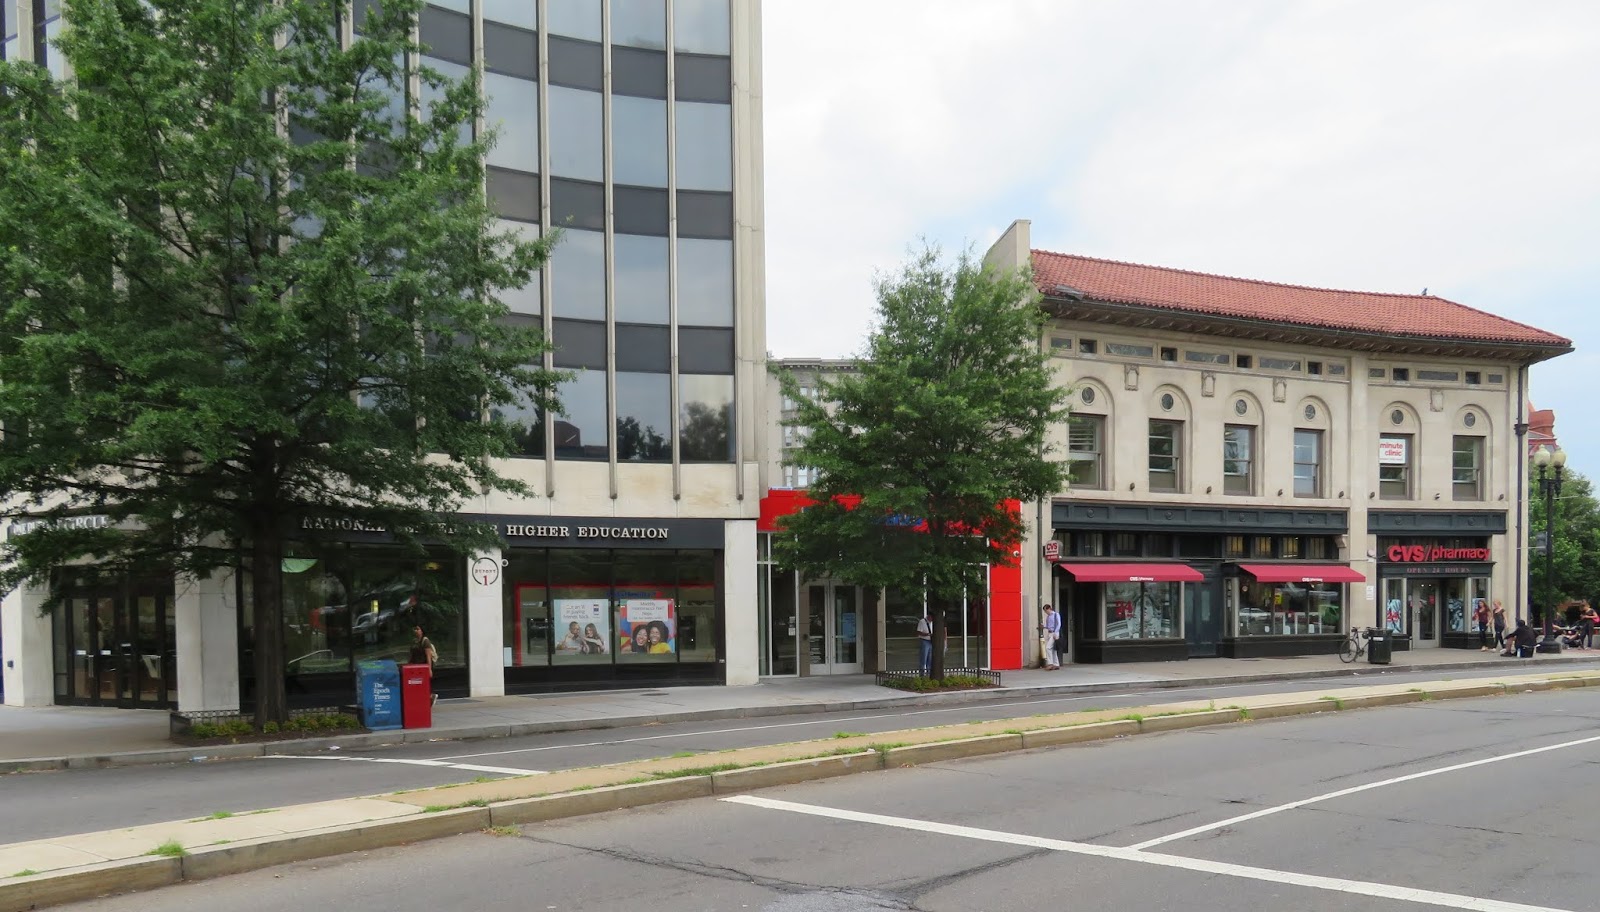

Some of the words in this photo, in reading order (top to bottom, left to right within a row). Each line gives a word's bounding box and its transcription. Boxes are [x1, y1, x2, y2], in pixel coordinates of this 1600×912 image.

[506, 524, 570, 537] HIGHER
[577, 526, 669, 539] EDUCATION
[1046, 543, 1058, 551] CVS
[483, 575, 488, 586] 1
